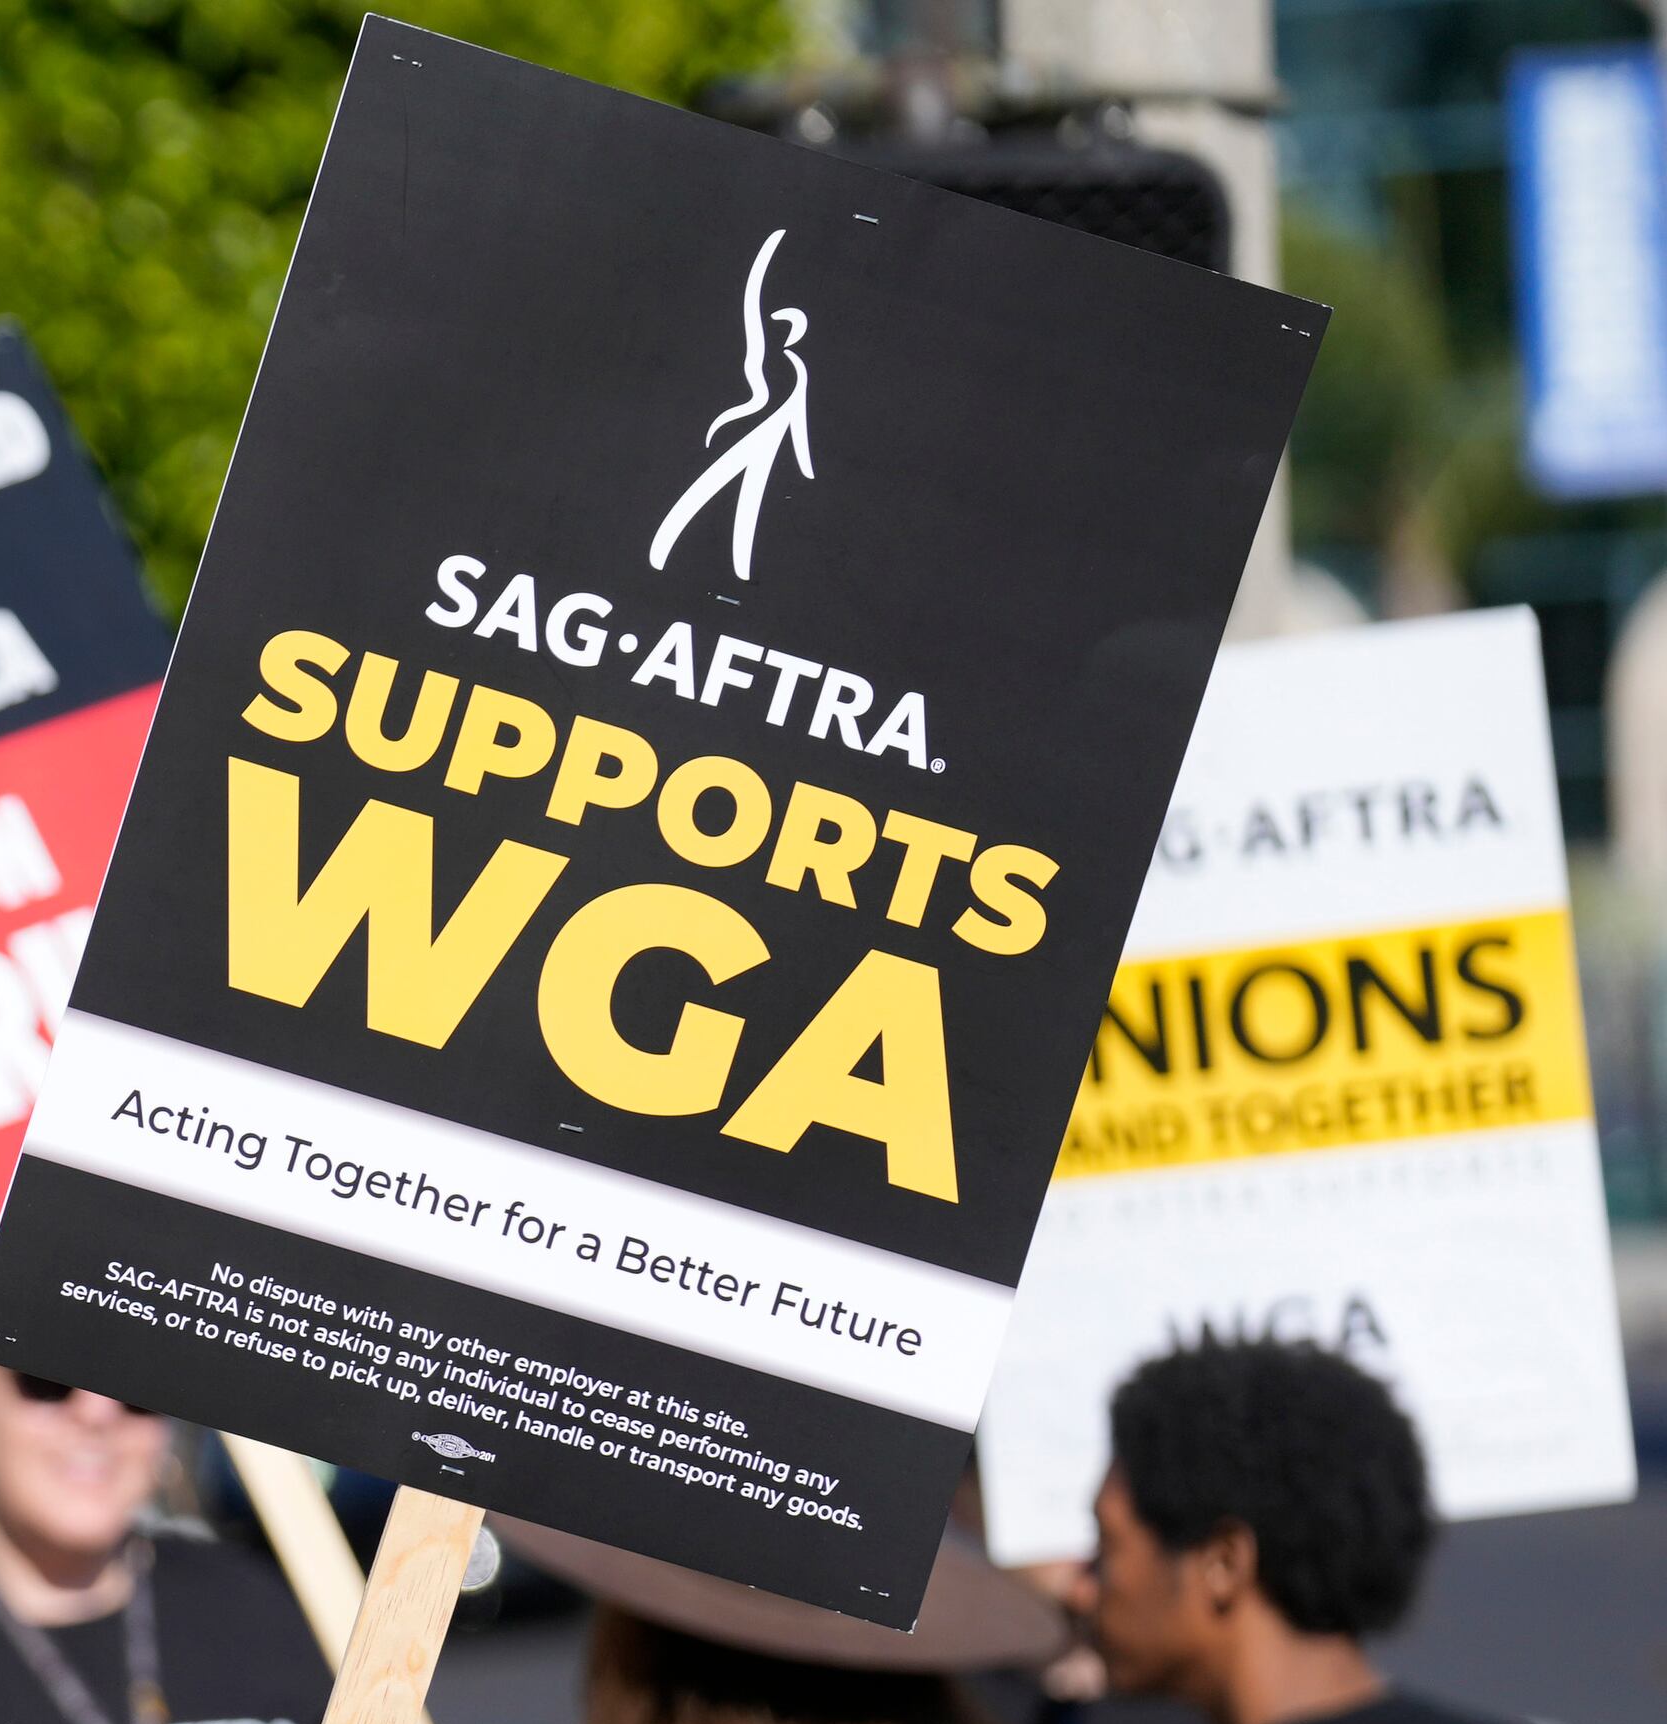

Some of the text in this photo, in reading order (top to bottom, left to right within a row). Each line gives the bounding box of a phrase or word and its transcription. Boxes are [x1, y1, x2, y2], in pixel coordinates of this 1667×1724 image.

[242, 631, 1060, 957] SUPPORTS
[1157, 775, 1504, 870] G·AFTRA
[228, 757, 958, 1204] WGA
[1091, 937, 1525, 1084] NIONS
[1067, 1068, 1537, 1164] AND TOGETHER
[111, 1090, 922, 1356] Acting Together for a Better Future
[60, 1282, 864, 1531] services, or to refuse to pick up, deliver, handle or transport any goods.
[105, 1262, 839, 1495] SAG-AFTRA is not asking any individual to cease performing any
[211, 1263, 748, 1438] No dispute with any other employer at this site.
[479, 1451, 496, 1463] 201
